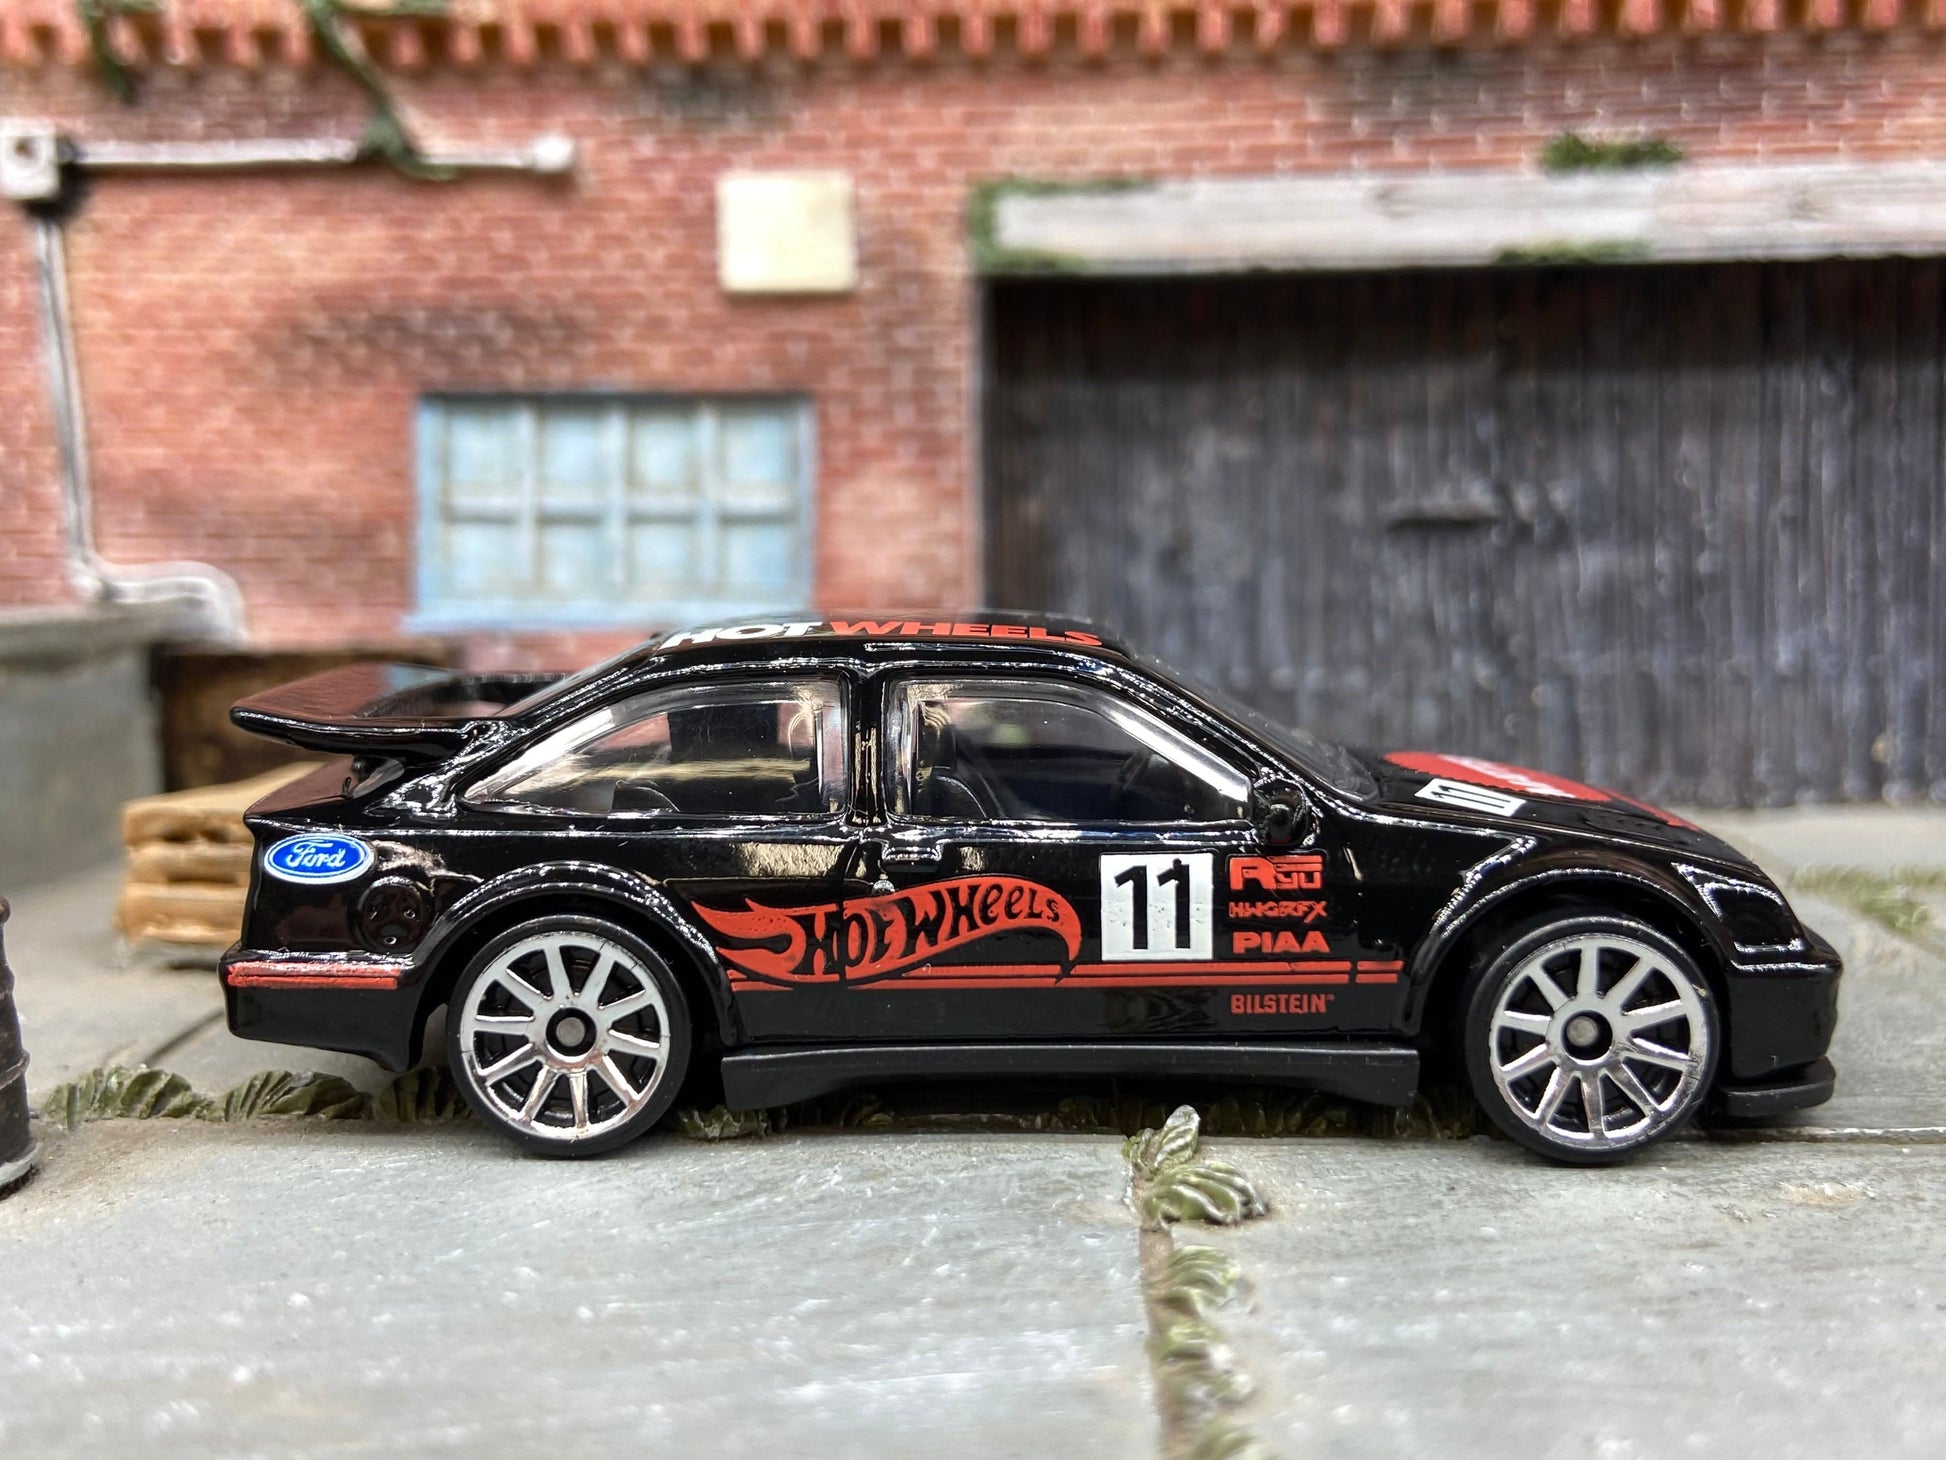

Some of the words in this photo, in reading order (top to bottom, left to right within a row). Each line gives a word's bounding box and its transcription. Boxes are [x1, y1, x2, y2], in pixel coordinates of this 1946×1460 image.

[658, 621, 823, 649] HOT
[830, 622, 1103, 646] WHEELS
[286, 840, 346, 868] Ford
[1114, 858, 1191, 950] 11
[1232, 931, 1331, 954] PIAA
